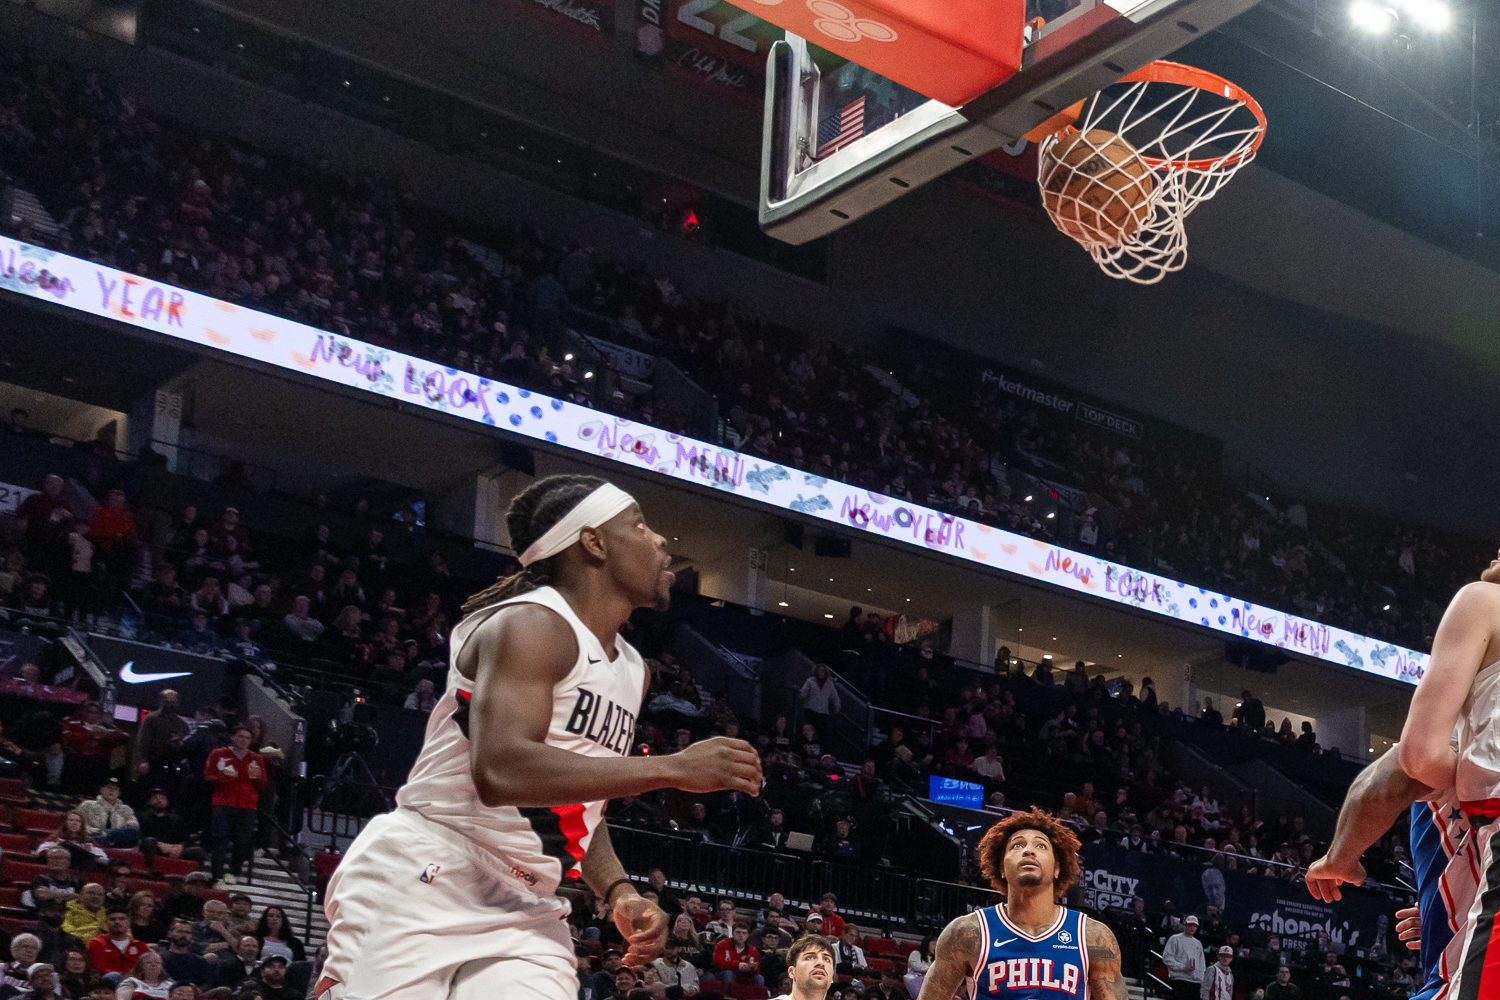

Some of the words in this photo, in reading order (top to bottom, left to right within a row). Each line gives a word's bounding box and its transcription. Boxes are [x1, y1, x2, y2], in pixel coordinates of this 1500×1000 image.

[97, 270, 184, 328] YEAR
[310, 334, 385, 382] New
[404, 360, 489, 420] LOOK
[624, 351, 652, 369] 319
[1083, 408, 1104, 423] TOP
[1108, 417, 1136, 434] DECK
[598, 423, 661, 465] New
[675, 441, 745, 487] MENU
[840, 495, 895, 533] New
[909, 513, 965, 550] YEAR
[1045, 549, 1093, 585] New
[1105, 564, 1163, 607] LOOK
[1232, 607, 1274, 638] New
[1284, 621, 1331, 655] MENU
[988, 958, 1080, 995] PHILA
